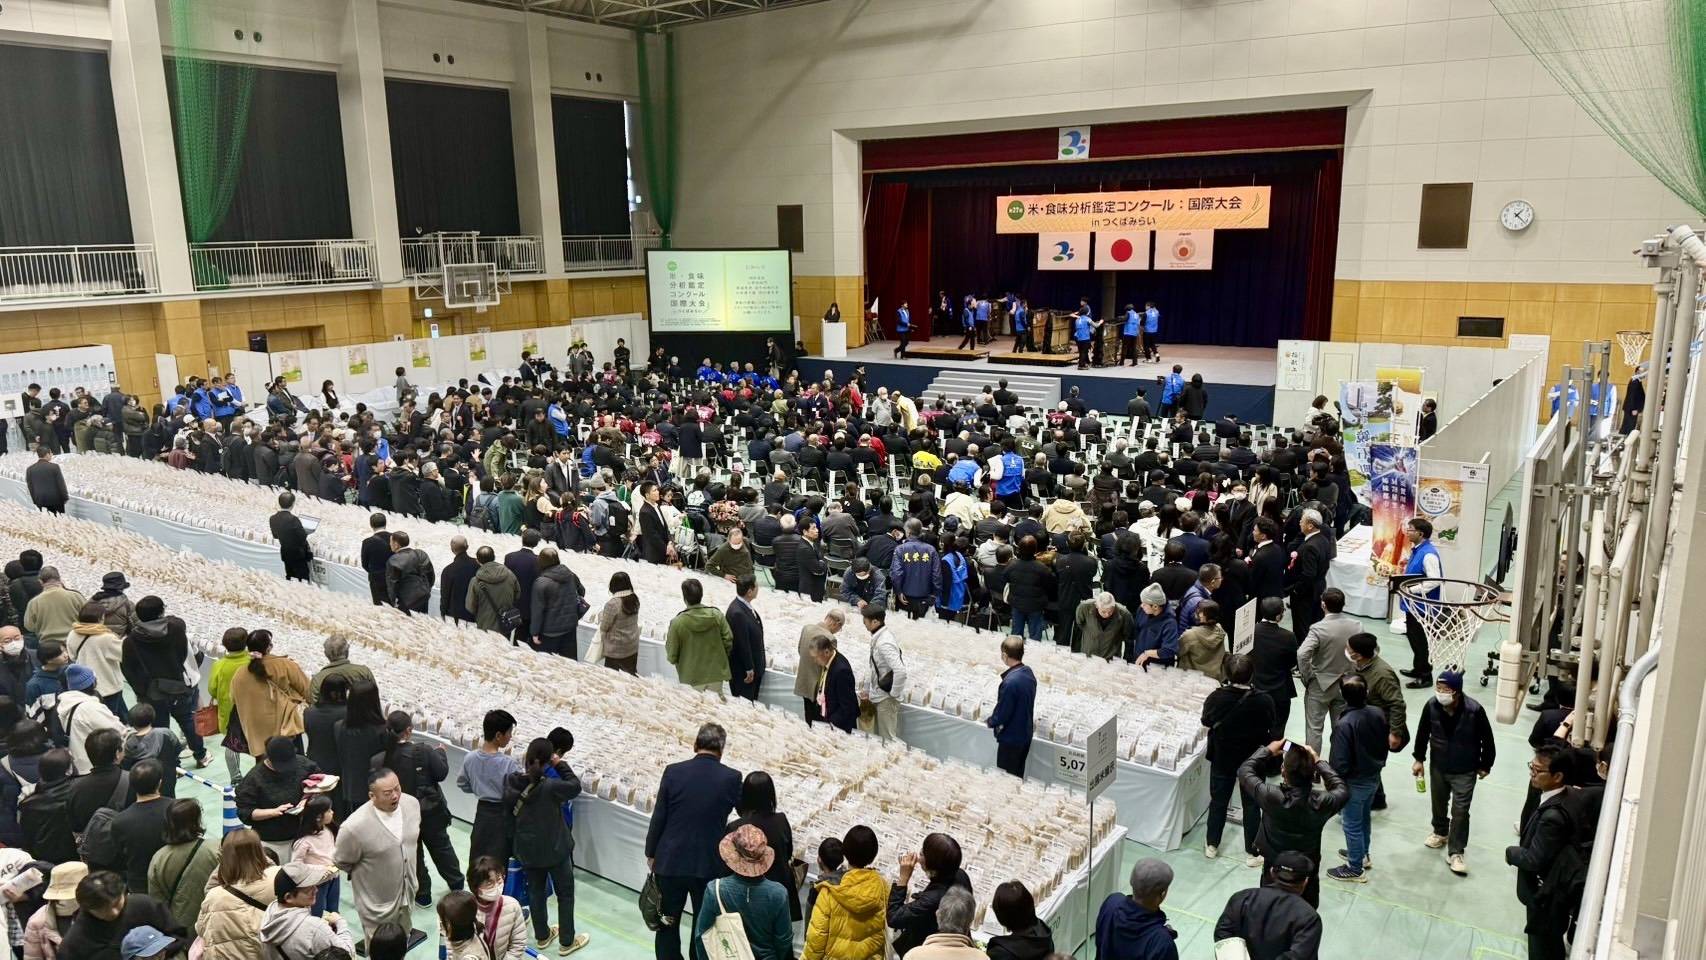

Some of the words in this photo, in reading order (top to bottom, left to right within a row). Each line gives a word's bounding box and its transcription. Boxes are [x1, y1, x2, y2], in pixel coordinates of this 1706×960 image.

[1027, 195, 1242, 216] 米・食味分析鑑定コンクール：国際大会
[1091, 218, 1100, 227] in
[1102, 216, 1156, 226] つくばみらい
[1060, 756, 1086, 772] 5,07
